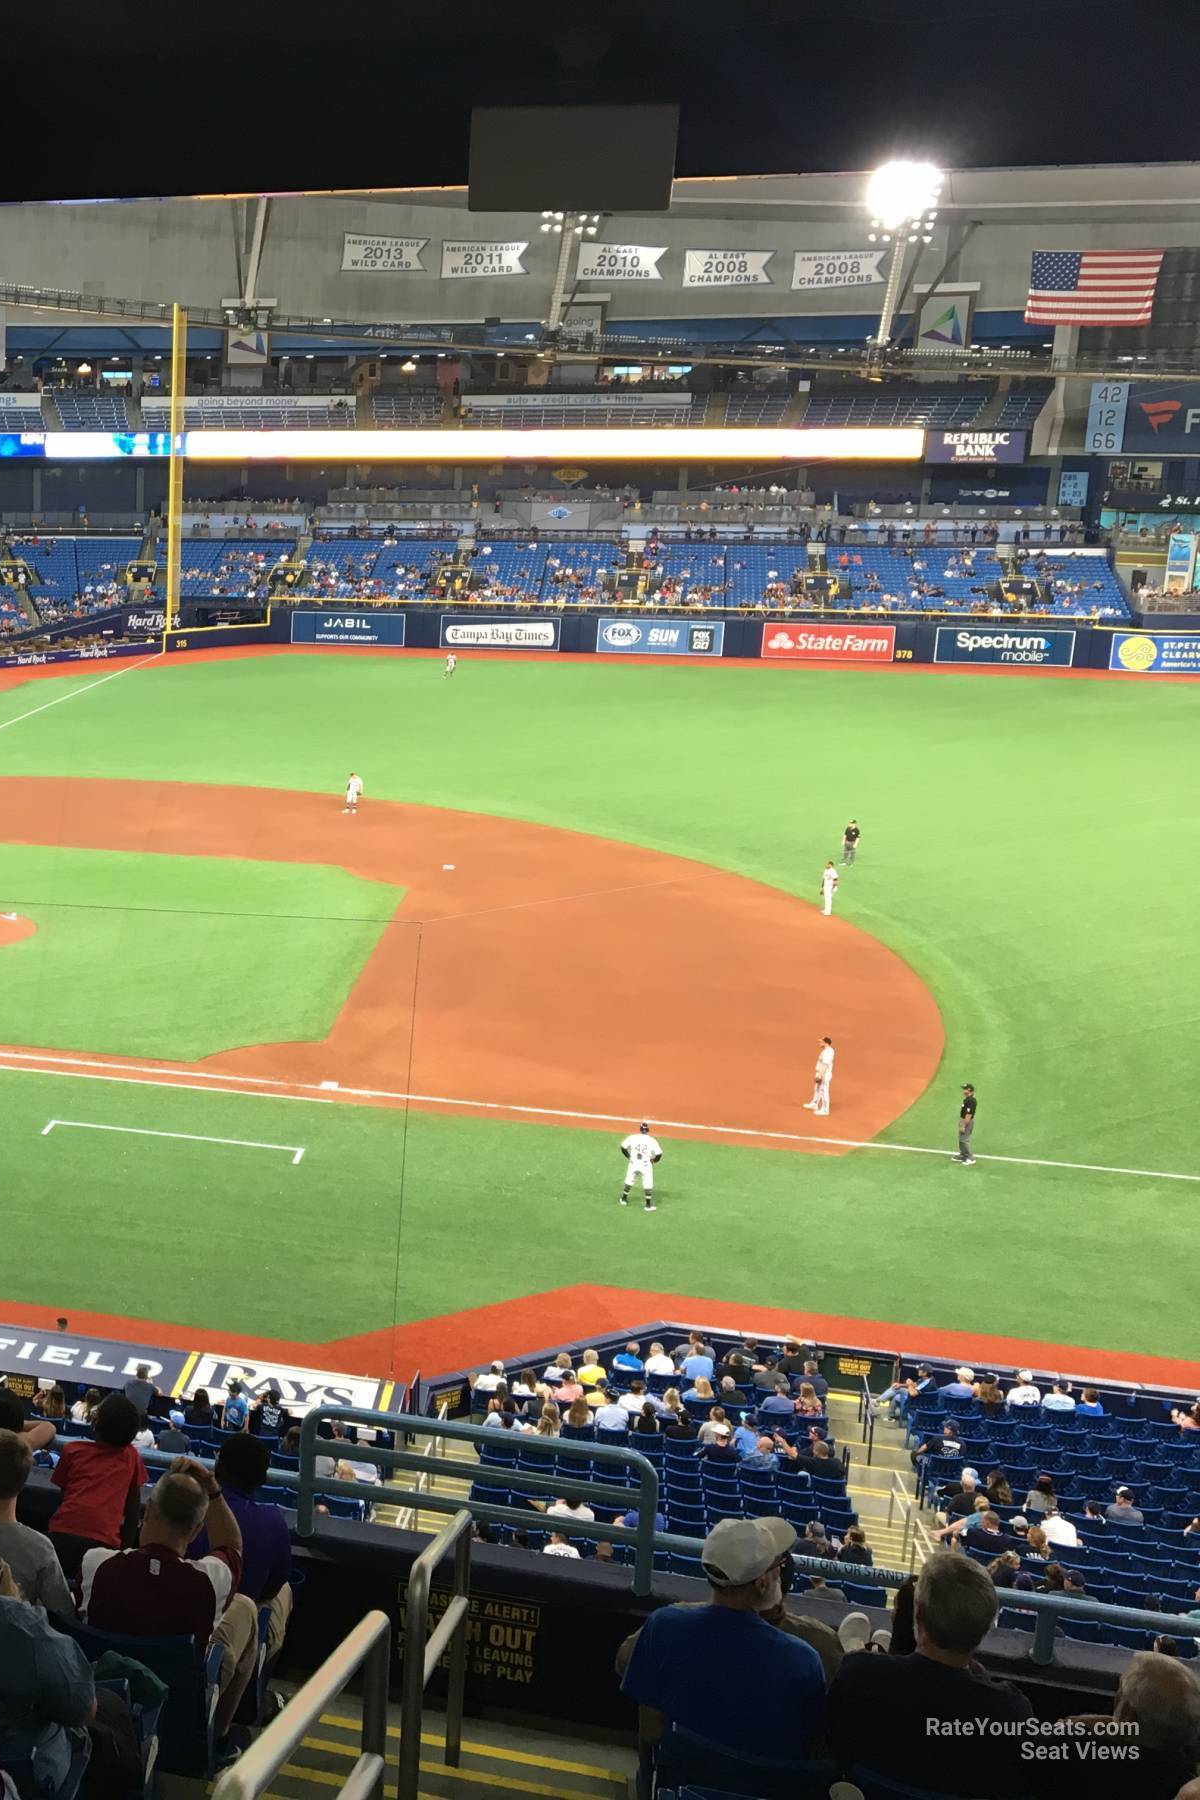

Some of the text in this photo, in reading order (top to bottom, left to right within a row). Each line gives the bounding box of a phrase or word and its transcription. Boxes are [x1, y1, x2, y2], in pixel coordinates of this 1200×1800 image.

[347, 239, 420, 248] AMERICAN LEAGUE
[446, 245, 487, 253] AMERICAN
[363, 247, 403, 260] 2013
[616, 247, 639, 255] EAST
[722, 252, 746, 260] EAST
[351, 259, 412, 269] WILD CARD
[463, 253, 504, 266] 2011
[596, 254, 641, 268] 2010
[800, 253, 875, 263] AMERICAN LEAGUE
[451, 265, 513, 274] WILD CARD
[582, 268, 651, 278] CHAMPIONS
[703, 261, 748, 274] 2008
[814, 261, 861, 276] 2008
[689, 274, 759, 284] CHAMPIONS
[799, 274, 873, 286] CHAMPIONS
[1098, 386, 1122, 403] 42
[198, 397, 300, 408] going beyond money
[1098, 410, 1116, 426] 12
[943, 432, 1010, 445] REPUBLIC
[1092, 433, 1116, 449] 66
[955, 444, 996, 456] BANK
[127, 613, 182, 628] Hard Rok
[323, 618, 371, 629] JABIL
[451, 628, 551, 643] Tampa Bay Times
[611, 628, 680, 643] FOX SUN
[692, 630, 711, 639] FOX
[176, 640, 188, 648] 315
[692, 642, 709, 650] GO
[956, 631, 1046, 651] Spectrum
[80, 647, 108, 658] Hard Rock
[896, 650, 913, 659] 378
[18, 654, 46, 665] Hard Rock
[201, 1360, 353, 1407] RAYS
[800, 1556, 814, 1567] SIT
[844, 1562, 860, 1574] OR
[863, 1566, 905, 1581] STAND
[484, 1603, 536, 1623] ALERT!
[490, 1624, 537, 1652] OUT
[475, 1648, 533, 1667] LEAVING
[497, 1665, 533, 1683] PLAY
